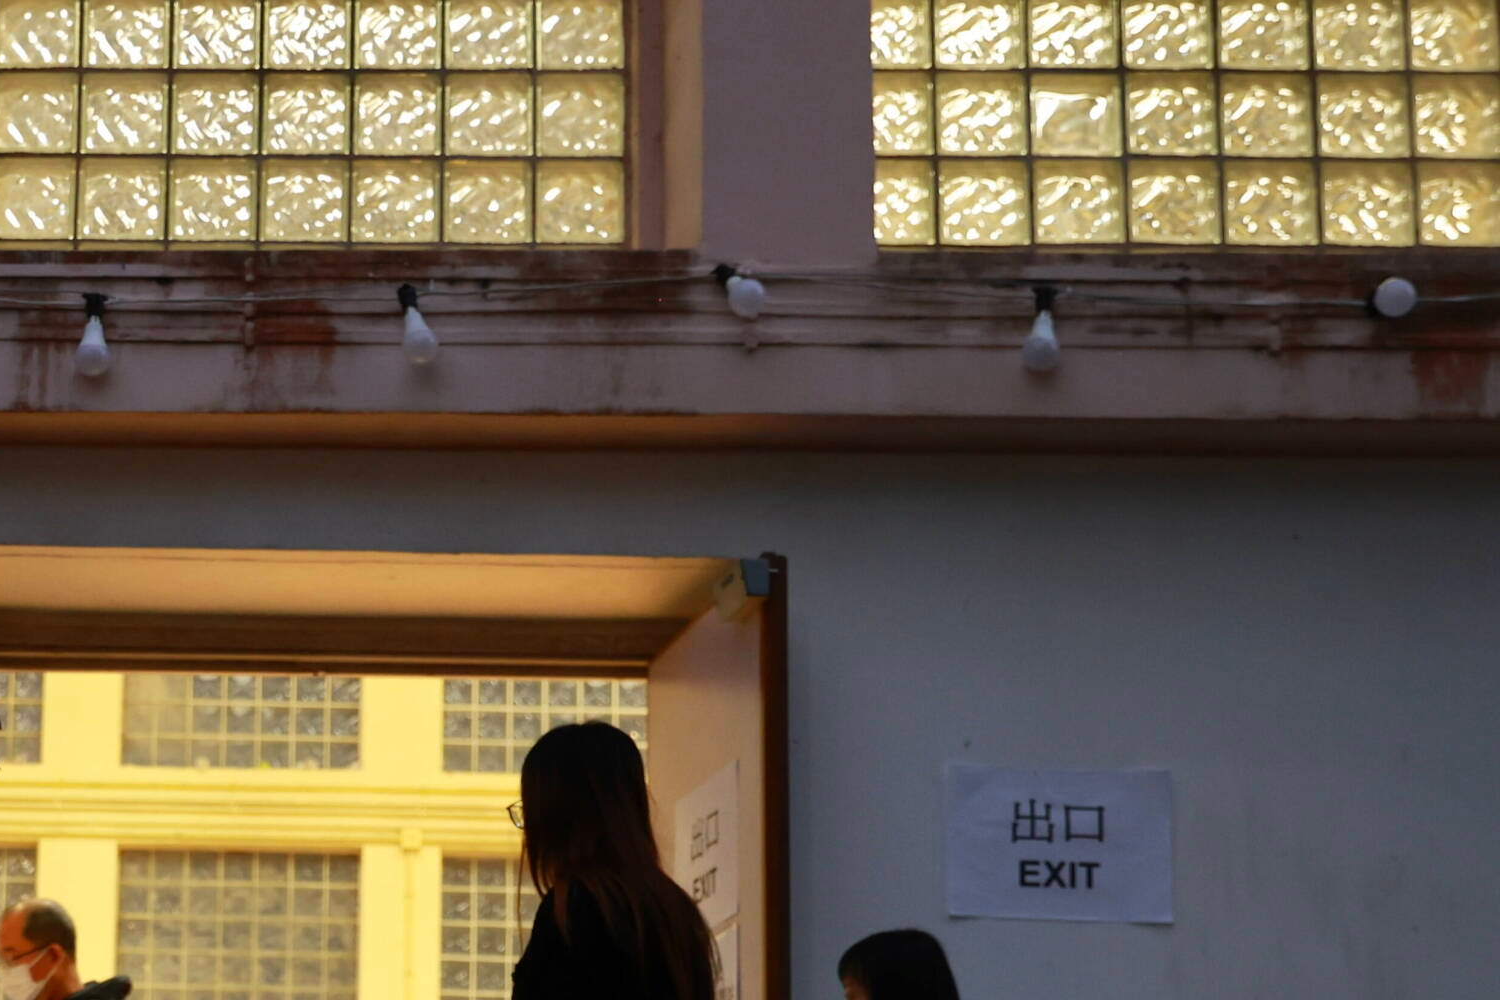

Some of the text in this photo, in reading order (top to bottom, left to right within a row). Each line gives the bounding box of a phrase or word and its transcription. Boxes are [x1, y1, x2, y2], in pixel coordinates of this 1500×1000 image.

[1011, 799, 1105, 843] 出口
[692, 867, 718, 903] EXIT
[1018, 860, 1101, 889] EXIT
